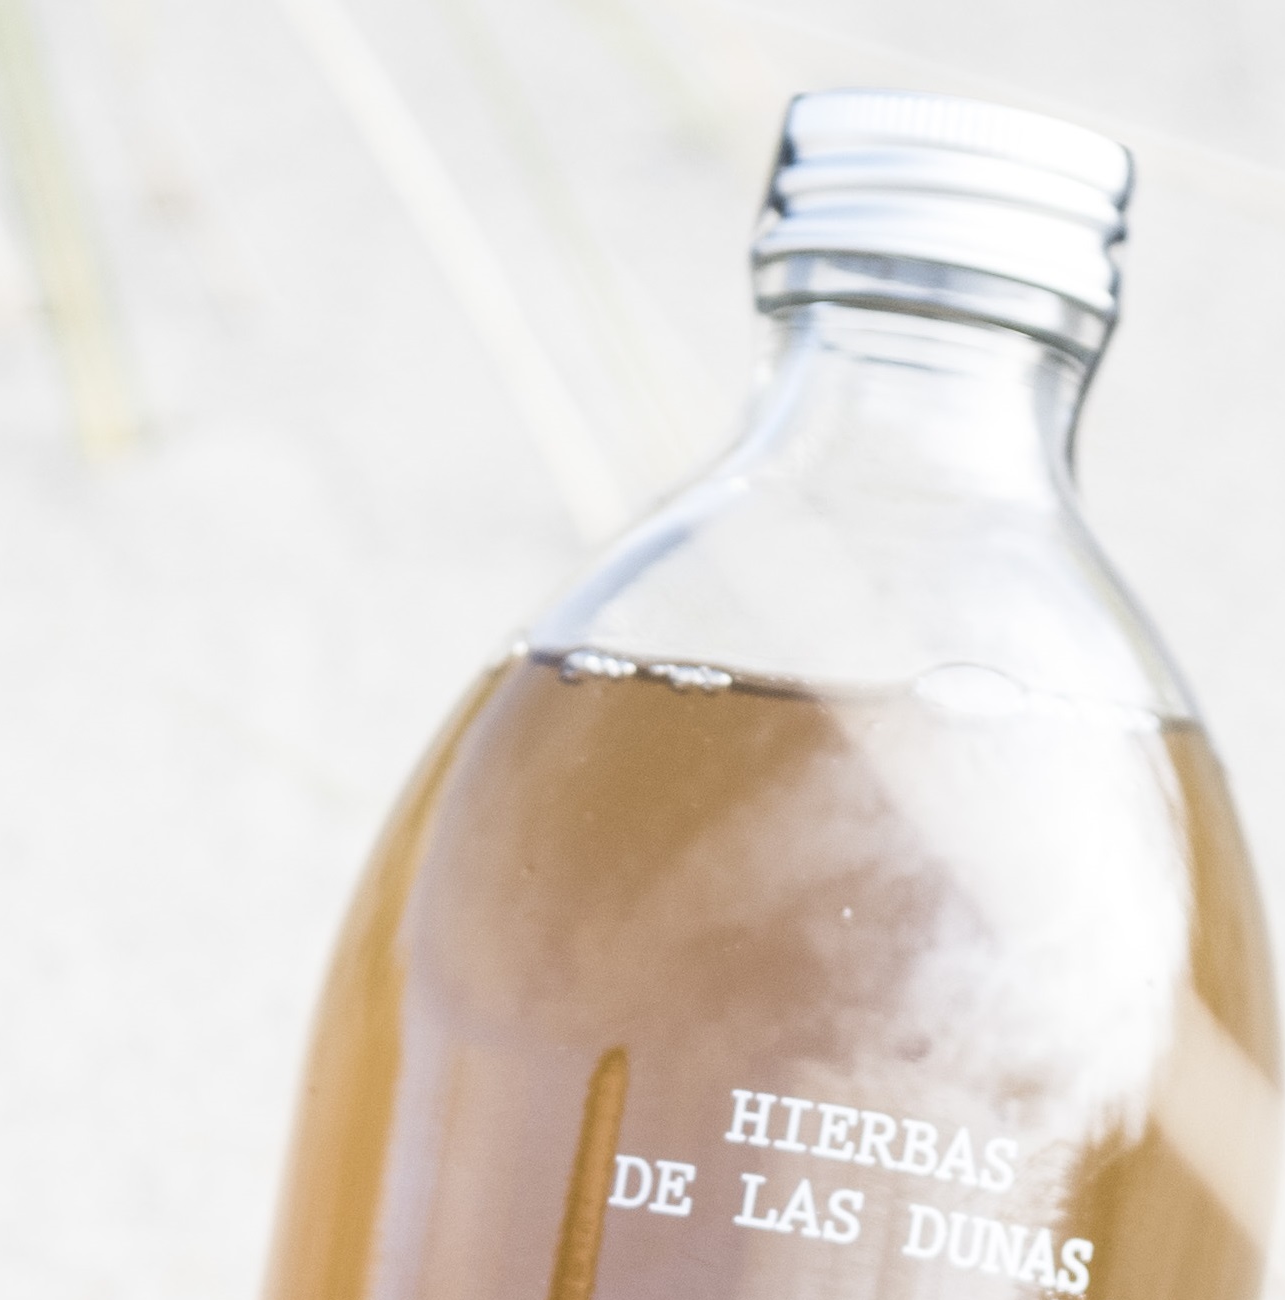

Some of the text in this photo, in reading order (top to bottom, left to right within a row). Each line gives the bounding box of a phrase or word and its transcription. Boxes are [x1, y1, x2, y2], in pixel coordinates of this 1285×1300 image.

[725, 1089, 1018, 1192] HIERBAS
[609, 1154, 1094, 1293] DE LAS DUNAS
